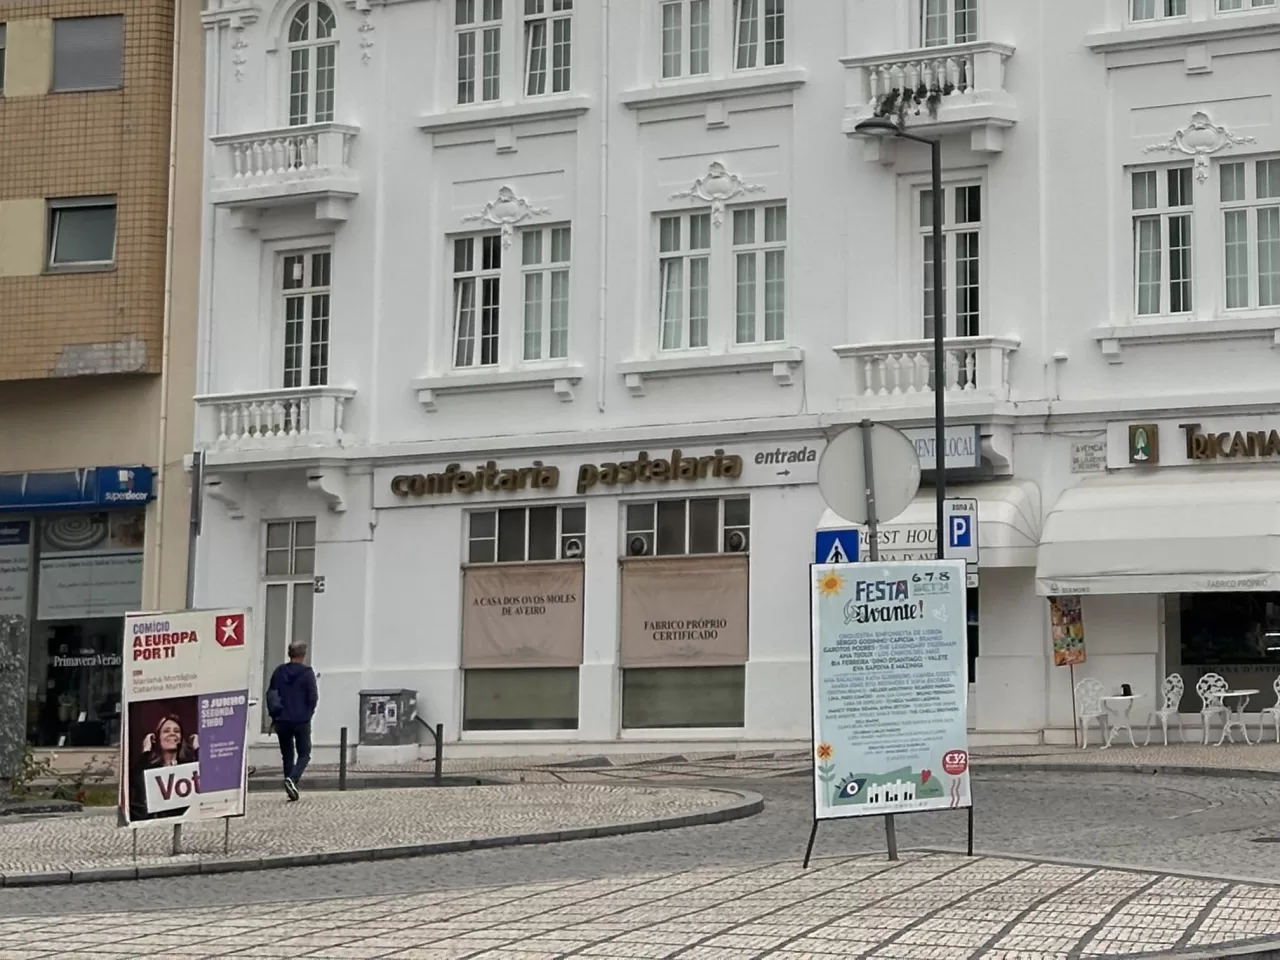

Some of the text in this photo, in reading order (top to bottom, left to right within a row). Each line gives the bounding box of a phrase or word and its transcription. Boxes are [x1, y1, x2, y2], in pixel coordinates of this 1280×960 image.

[945, 436, 975, 457] LOCAL
[754, 446, 817, 465] entrada
[390, 448, 744, 497] confeitaria pastelaria
[105, 490, 148, 501] superdecor
[953, 517, 966, 545] P
[855, 580, 909, 602] FESTA
[473, 594, 576, 606] A CASA DOS OVOS MOLES
[501, 606, 546, 616] DE AVEIRO
[133, 621, 170, 635] COMÍCIO
[644, 621, 685, 631] FABRICO
[133, 631, 198, 648] A EUROPA
[652, 630, 718, 641] CERTIFICADO
[133, 646, 175, 661] POR TI
[201, 699, 209, 709] 3
